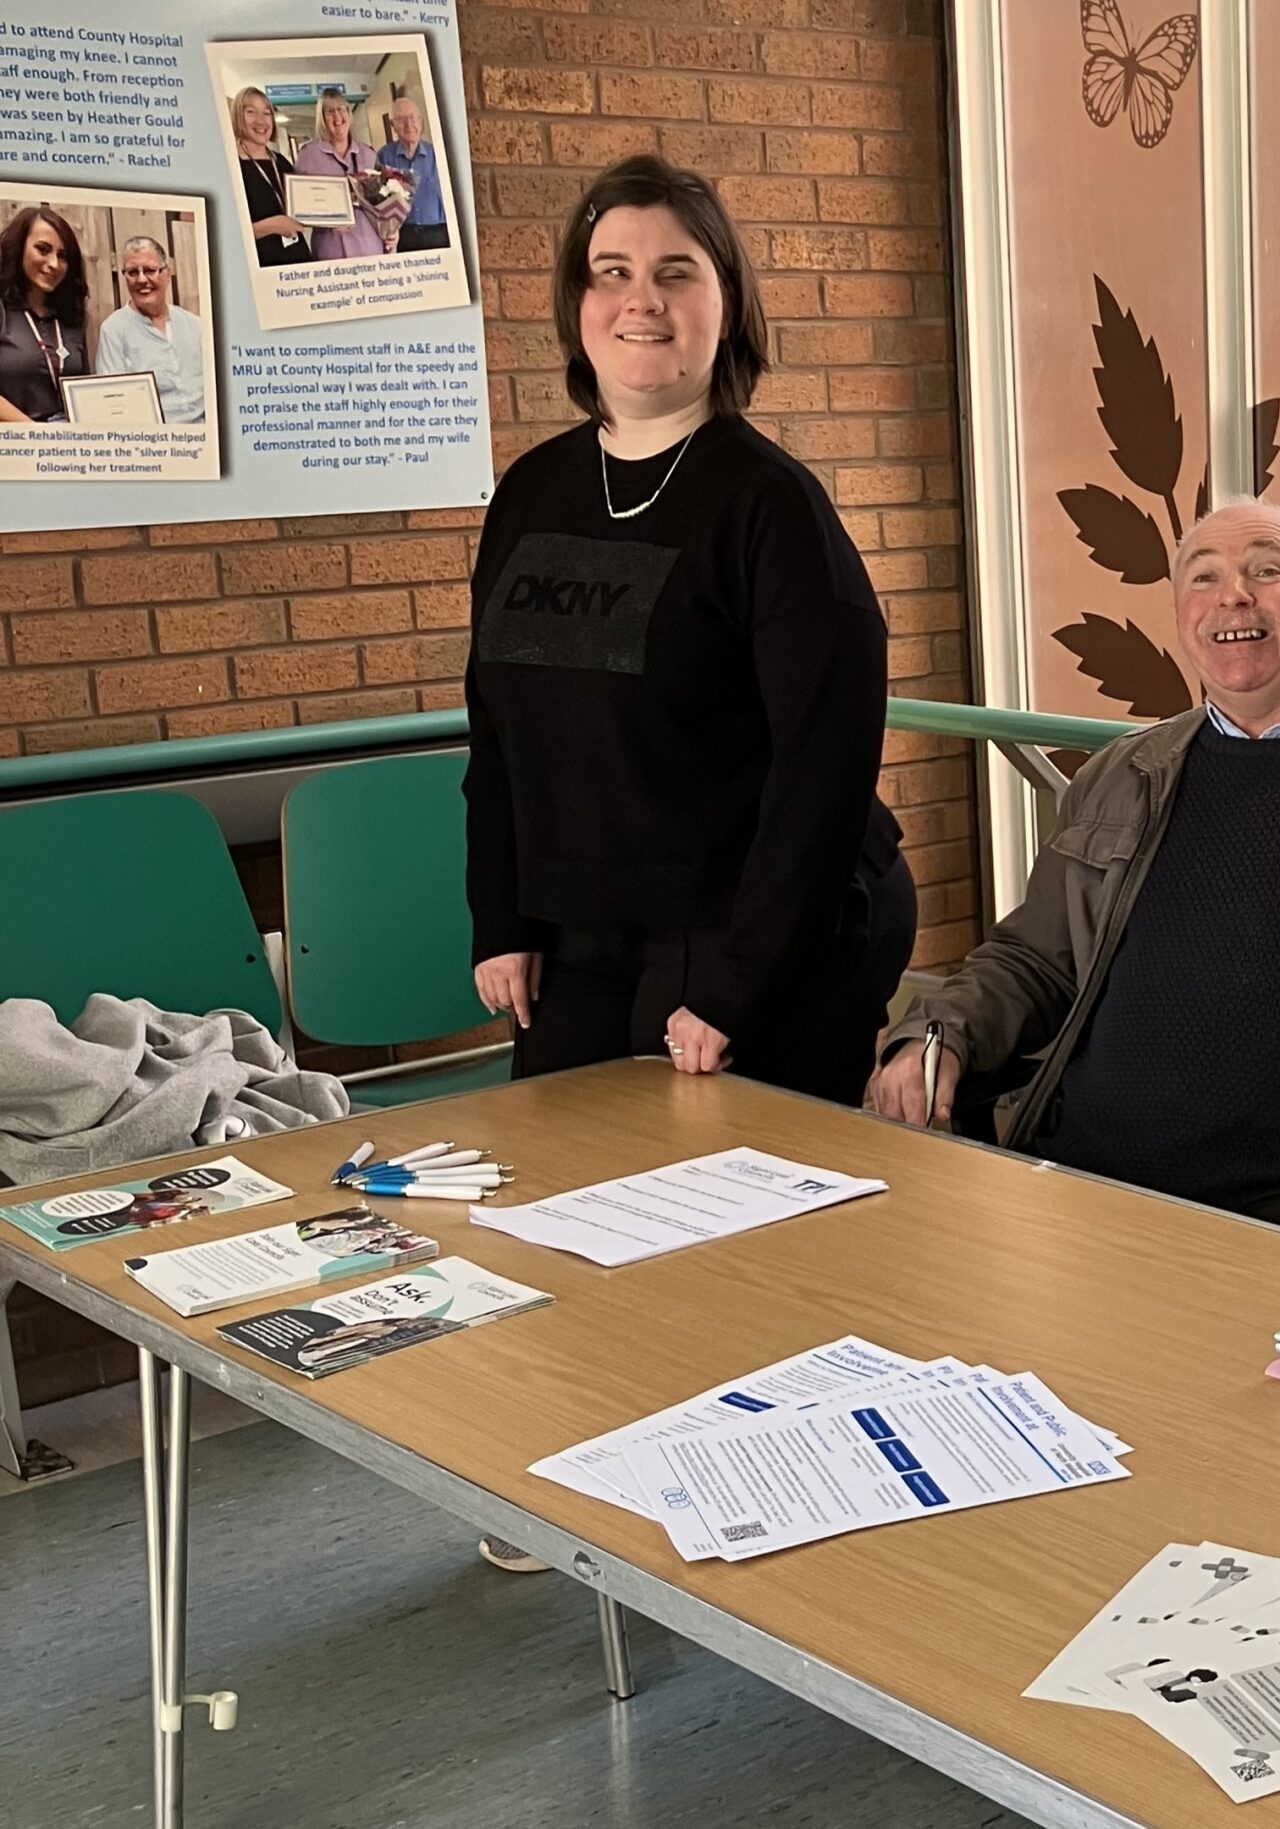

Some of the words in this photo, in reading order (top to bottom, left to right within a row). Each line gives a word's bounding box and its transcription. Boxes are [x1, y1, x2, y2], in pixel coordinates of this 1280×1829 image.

[322, 5, 355, 17] easier
[360, 8, 372, 18] to
[376, 9, 408, 22] bare."
[420, 12, 449, 27] Kerry
[12, 24, 25, 36] to
[30, 24, 73, 39] attend
[79, 28, 125, 45] County
[130, 32, 183, 48] Hospital
[0, 46, 56, 62] amaging
[60, 50, 79, 63] my
[84, 48, 121, 63] knee.
[125, 52, 129, 63] I
[133, 54, 177, 67] cannot
[24, 67, 79, 83] enough.
[84, 70, 117, 83] From
[122, 72, 183, 88] reception
[25, 89, 59, 101] were
[64, 89, 95, 102] both
[100, 91, 149, 108] friendly
[154, 95, 178, 107] and
[0, 109, 27, 119] was
[32, 110, 62, 122] seen
[67, 109, 82, 124] by
[88, 112, 140, 126] Heather
[145, 114, 183, 128] Gould
[62, 130, 65, 142] I
[70, 133, 90, 143] am
[95, 134, 109, 144] so
[113, 133, 163, 148] grateful
[168, 135, 185, 148] for
[23, 150, 47, 162] and
[52, 153, 115, 165] concern."
[128, 154, 170, 167] Rachel
[279, 268, 309, 282] Father
[314, 266, 331, 277] and
[334, 262, 376, 276] daughter
[379, 258, 401, 271] have
[404, 255, 441, 268] thanked
[276, 284, 314, 298] Nursing
[317, 278, 358, 293] Assistant
[362, 277, 374, 288] for
[378, 273, 404, 287] being
[407, 275, 411, 283] a
[413, 270, 449, 282] 'shining
[311, 297, 353, 311] example'
[356, 293, 365, 305] of
[368, 290, 422, 304] compassion
[245, 346, 275, 357] want
[279, 346, 291, 357] to
[295, 344, 364, 358] compliment
[367, 343, 391, 355] staff
[394, 344, 404, 355] in
[408, 343, 431, 355] A&E
[435, 343, 455, 354] and
[458, 342, 475, 354] the
[232, 365, 262, 376] MRU
[266, 365, 277, 375] at
[281, 364, 322, 377] County
[326, 363, 372, 376] Hospital
[376, 362, 392, 373] for
[395, 362, 413, 373] the
[417, 361, 455, 375] speedy
[458, 361, 478, 372] and
[247, 382, 319, 397] professional
[323, 384, 345, 395] way
[349, 381, 352, 392] I
[356, 382, 377, 392] was
[381, 380, 409, 391] dealt
[412, 379, 440, 390] with.
[442, 379, 446, 390] I
[449, 380, 467, 390] can
[239, 404, 259, 414] not
[263, 402, 298, 416] praise
[302, 401, 321, 412] the
[325, 400, 349, 411] staff
[353, 399, 386, 413] highly
[390, 398, 430, 411] enough
[434, 397, 449, 408] for
[452, 397, 477, 407] their
[241, 419, 314, 435] professional
[317, 418, 360, 430] manner
[365, 416, 385, 429] and
[389, 416, 405, 428] for
[408, 416, 425, 427] the
[429, 417, 451, 426] care
[455, 415, 478, 427] they
[29, 431, 104, 441] Rehabilitation
[107, 432, 168, 443] Physiologist
[172, 432, 205, 442] helped
[253, 436, 336, 451] demonstrated
[340, 437, 351, 448] to
[354, 435, 380, 447] both
[384, 436, 400, 446] me
[404, 433, 424, 445] and
[428, 435, 444, 447] my
[447, 432, 470, 443] wife
[0, 447, 36, 456] cancer
[39, 447, 76, 457] patient
[80, 447, 91, 456] to
[115, 447, 131, 456] the
[135, 447, 167, 457] "silver
[171, 447, 203, 458] lining"
[302, 455, 340, 468] during
[343, 456, 361, 466] our
[366, 453, 394, 466] stay."
[405, 451, 429, 463] Paul
[37, 463, 86, 474] following
[89, 463, 106, 472] her
[110, 463, 162, 473] treatment
[502, 574, 633, 616] DKNY
[384, 1281, 431, 1304] Ask.
[840, 1343, 889, 1364] Patient
[990, 1385, 1031, 1424] Involvement
[1024, 1421, 1041, 1431] at
[1011, 1381, 1038, 1409] Patient
[1032, 1404, 1050, 1418] and
[1041, 1413, 1068, 1438] Public
